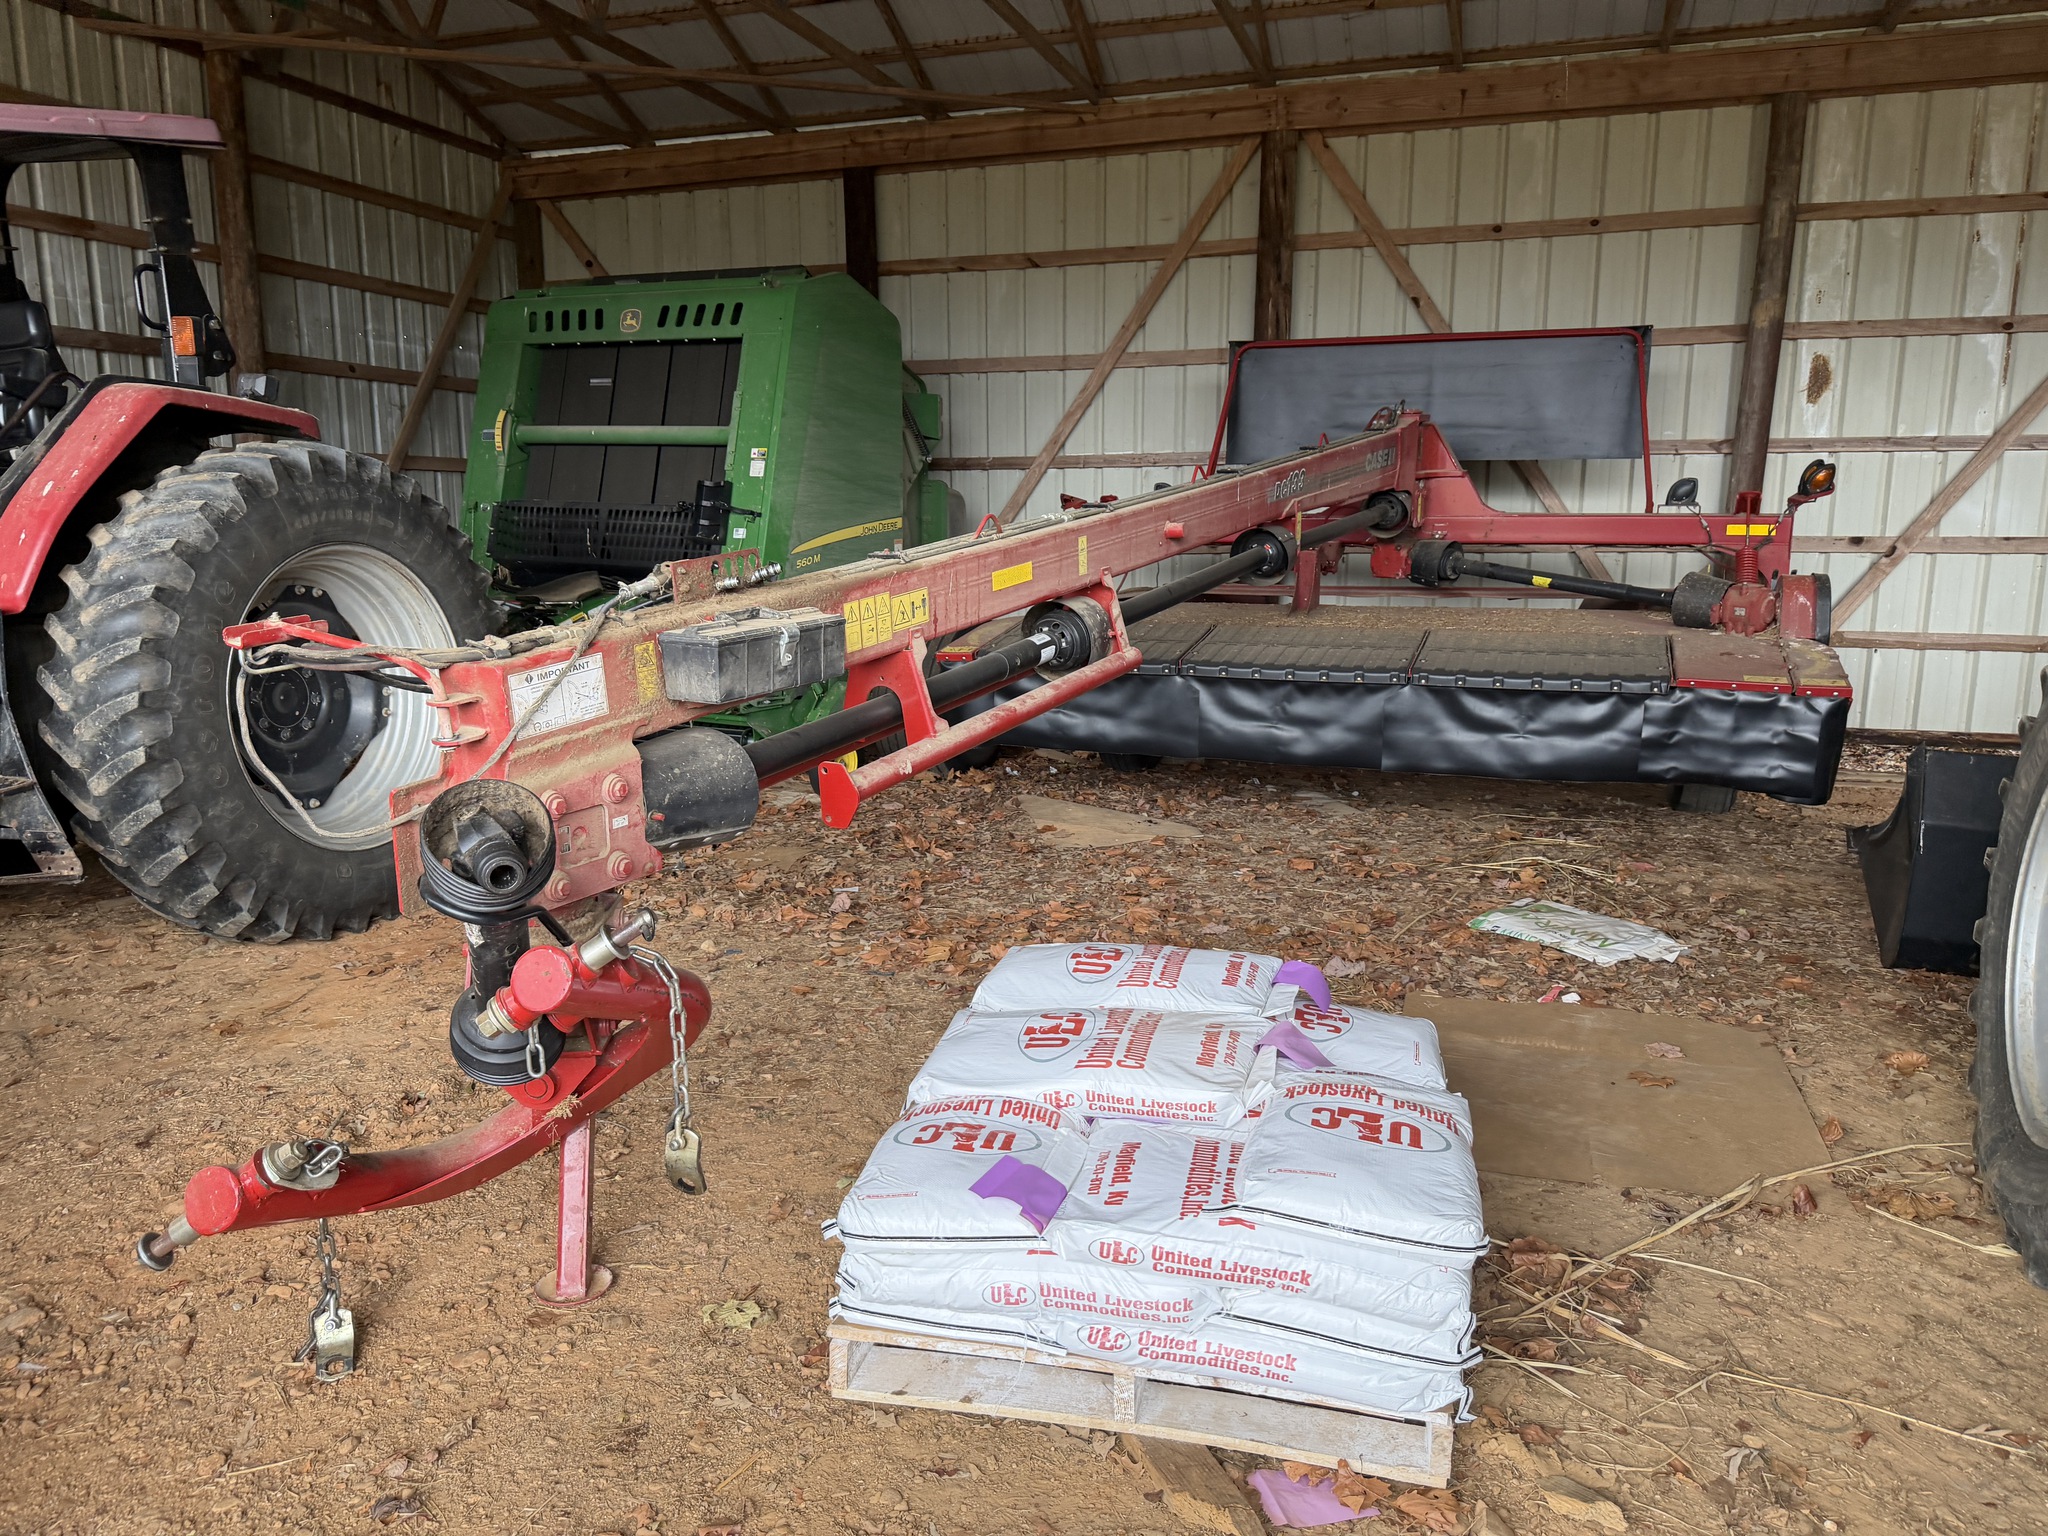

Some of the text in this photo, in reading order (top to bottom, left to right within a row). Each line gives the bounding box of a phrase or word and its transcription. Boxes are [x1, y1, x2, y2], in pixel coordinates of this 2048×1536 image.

[1365, 450, 1389, 472] CASE
[860, 521, 898, 537] JOHN DEERE
[796, 553, 821, 569] 560 M
[536, 660, 591, 682] IMPOANT
[1116, 961, 1155, 988] United
[1024, 1011, 1087, 1050] ULC
[1073, 1037, 1120, 1069] United
[1196, 1029, 1223, 1068] Mayfield,
[999, 1097, 1062, 1131] United
[1085, 1089, 1218, 1115] United Livestock
[911, 1121, 1017, 1153] ULC
[1310, 1105, 1424, 1150] ULC
[1104, 1141, 1142, 1206] Mayfield, Ky
[1098, 1240, 1138, 1265] ULC
[1151, 1244, 1313, 1287] United Livestock
[990, 1283, 1028, 1306] ULC
[1039, 1281, 1194, 1313] United Livestock
[1087, 1325, 1126, 1351] ULC
[1138, 1330, 1298, 1372] United Livestock
